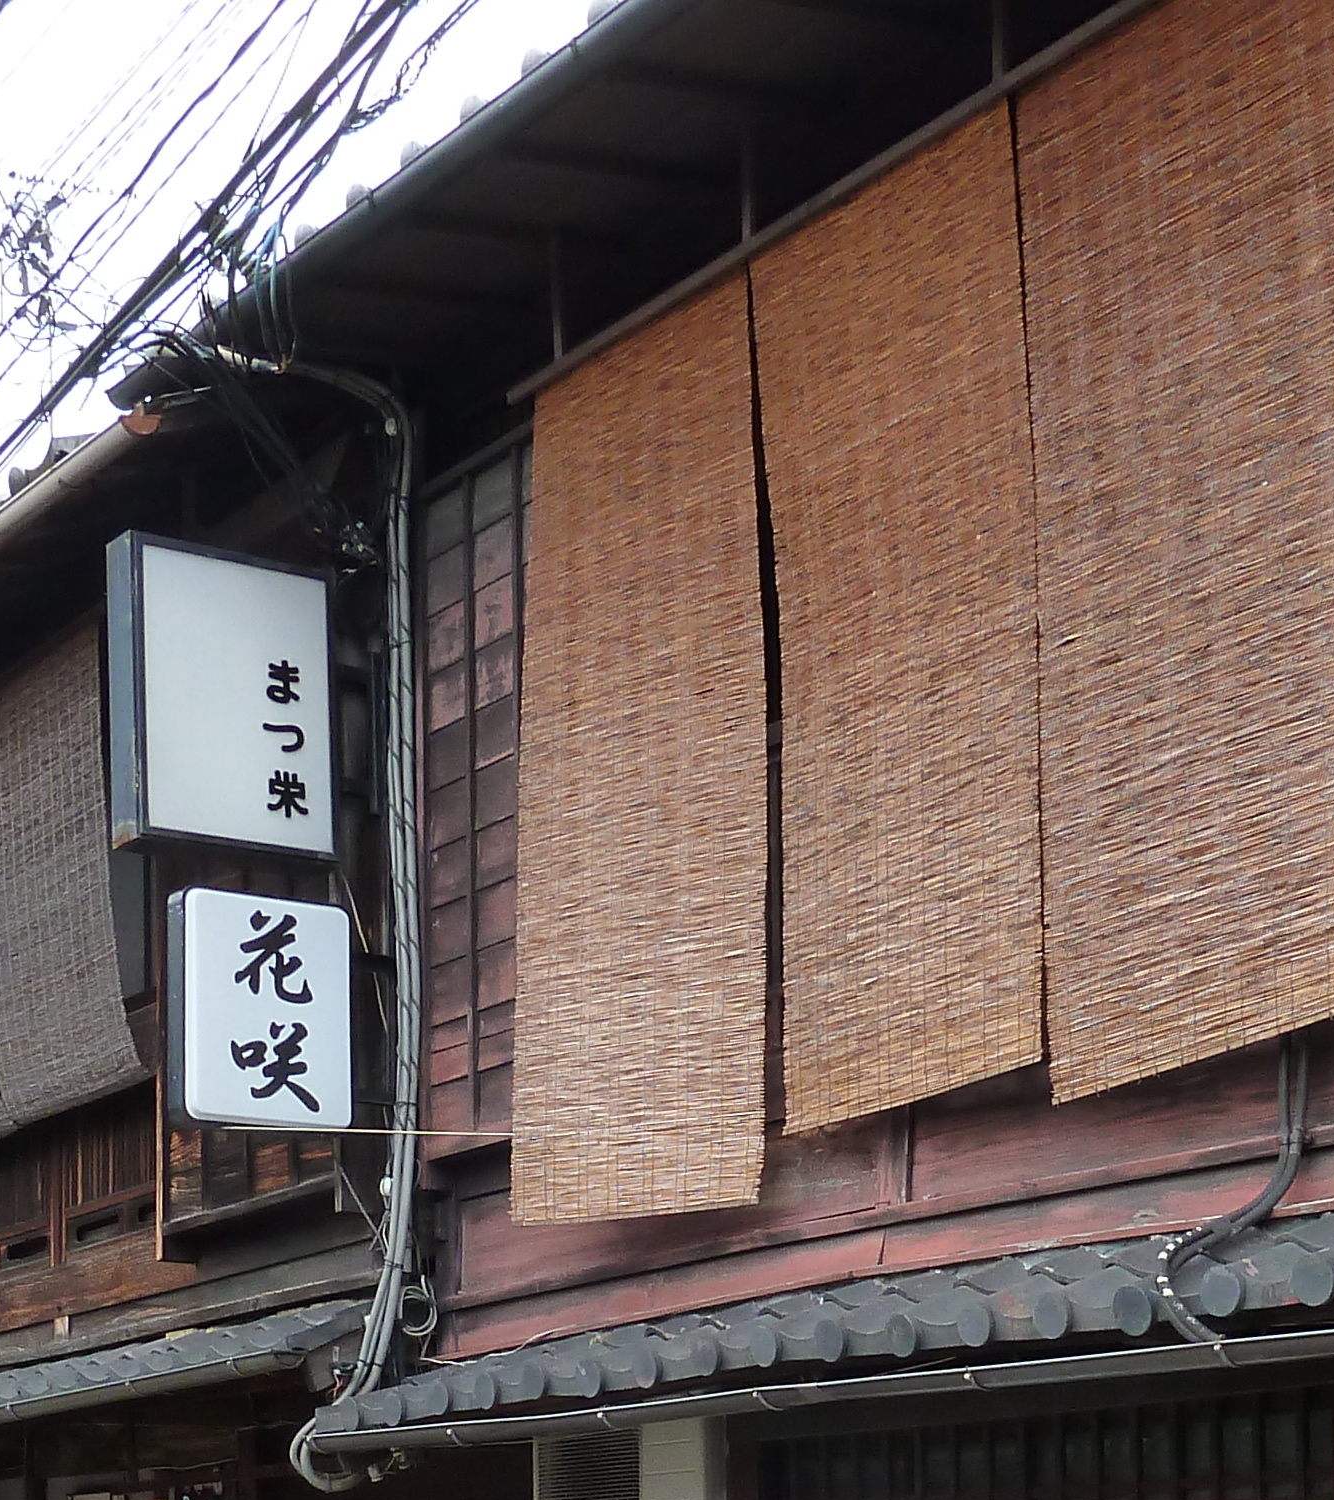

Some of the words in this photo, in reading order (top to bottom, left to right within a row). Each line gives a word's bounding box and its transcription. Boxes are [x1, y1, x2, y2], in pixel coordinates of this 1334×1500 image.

[263, 659, 308, 818] まつ栄
[230, 908, 321, 1114] 花咲
